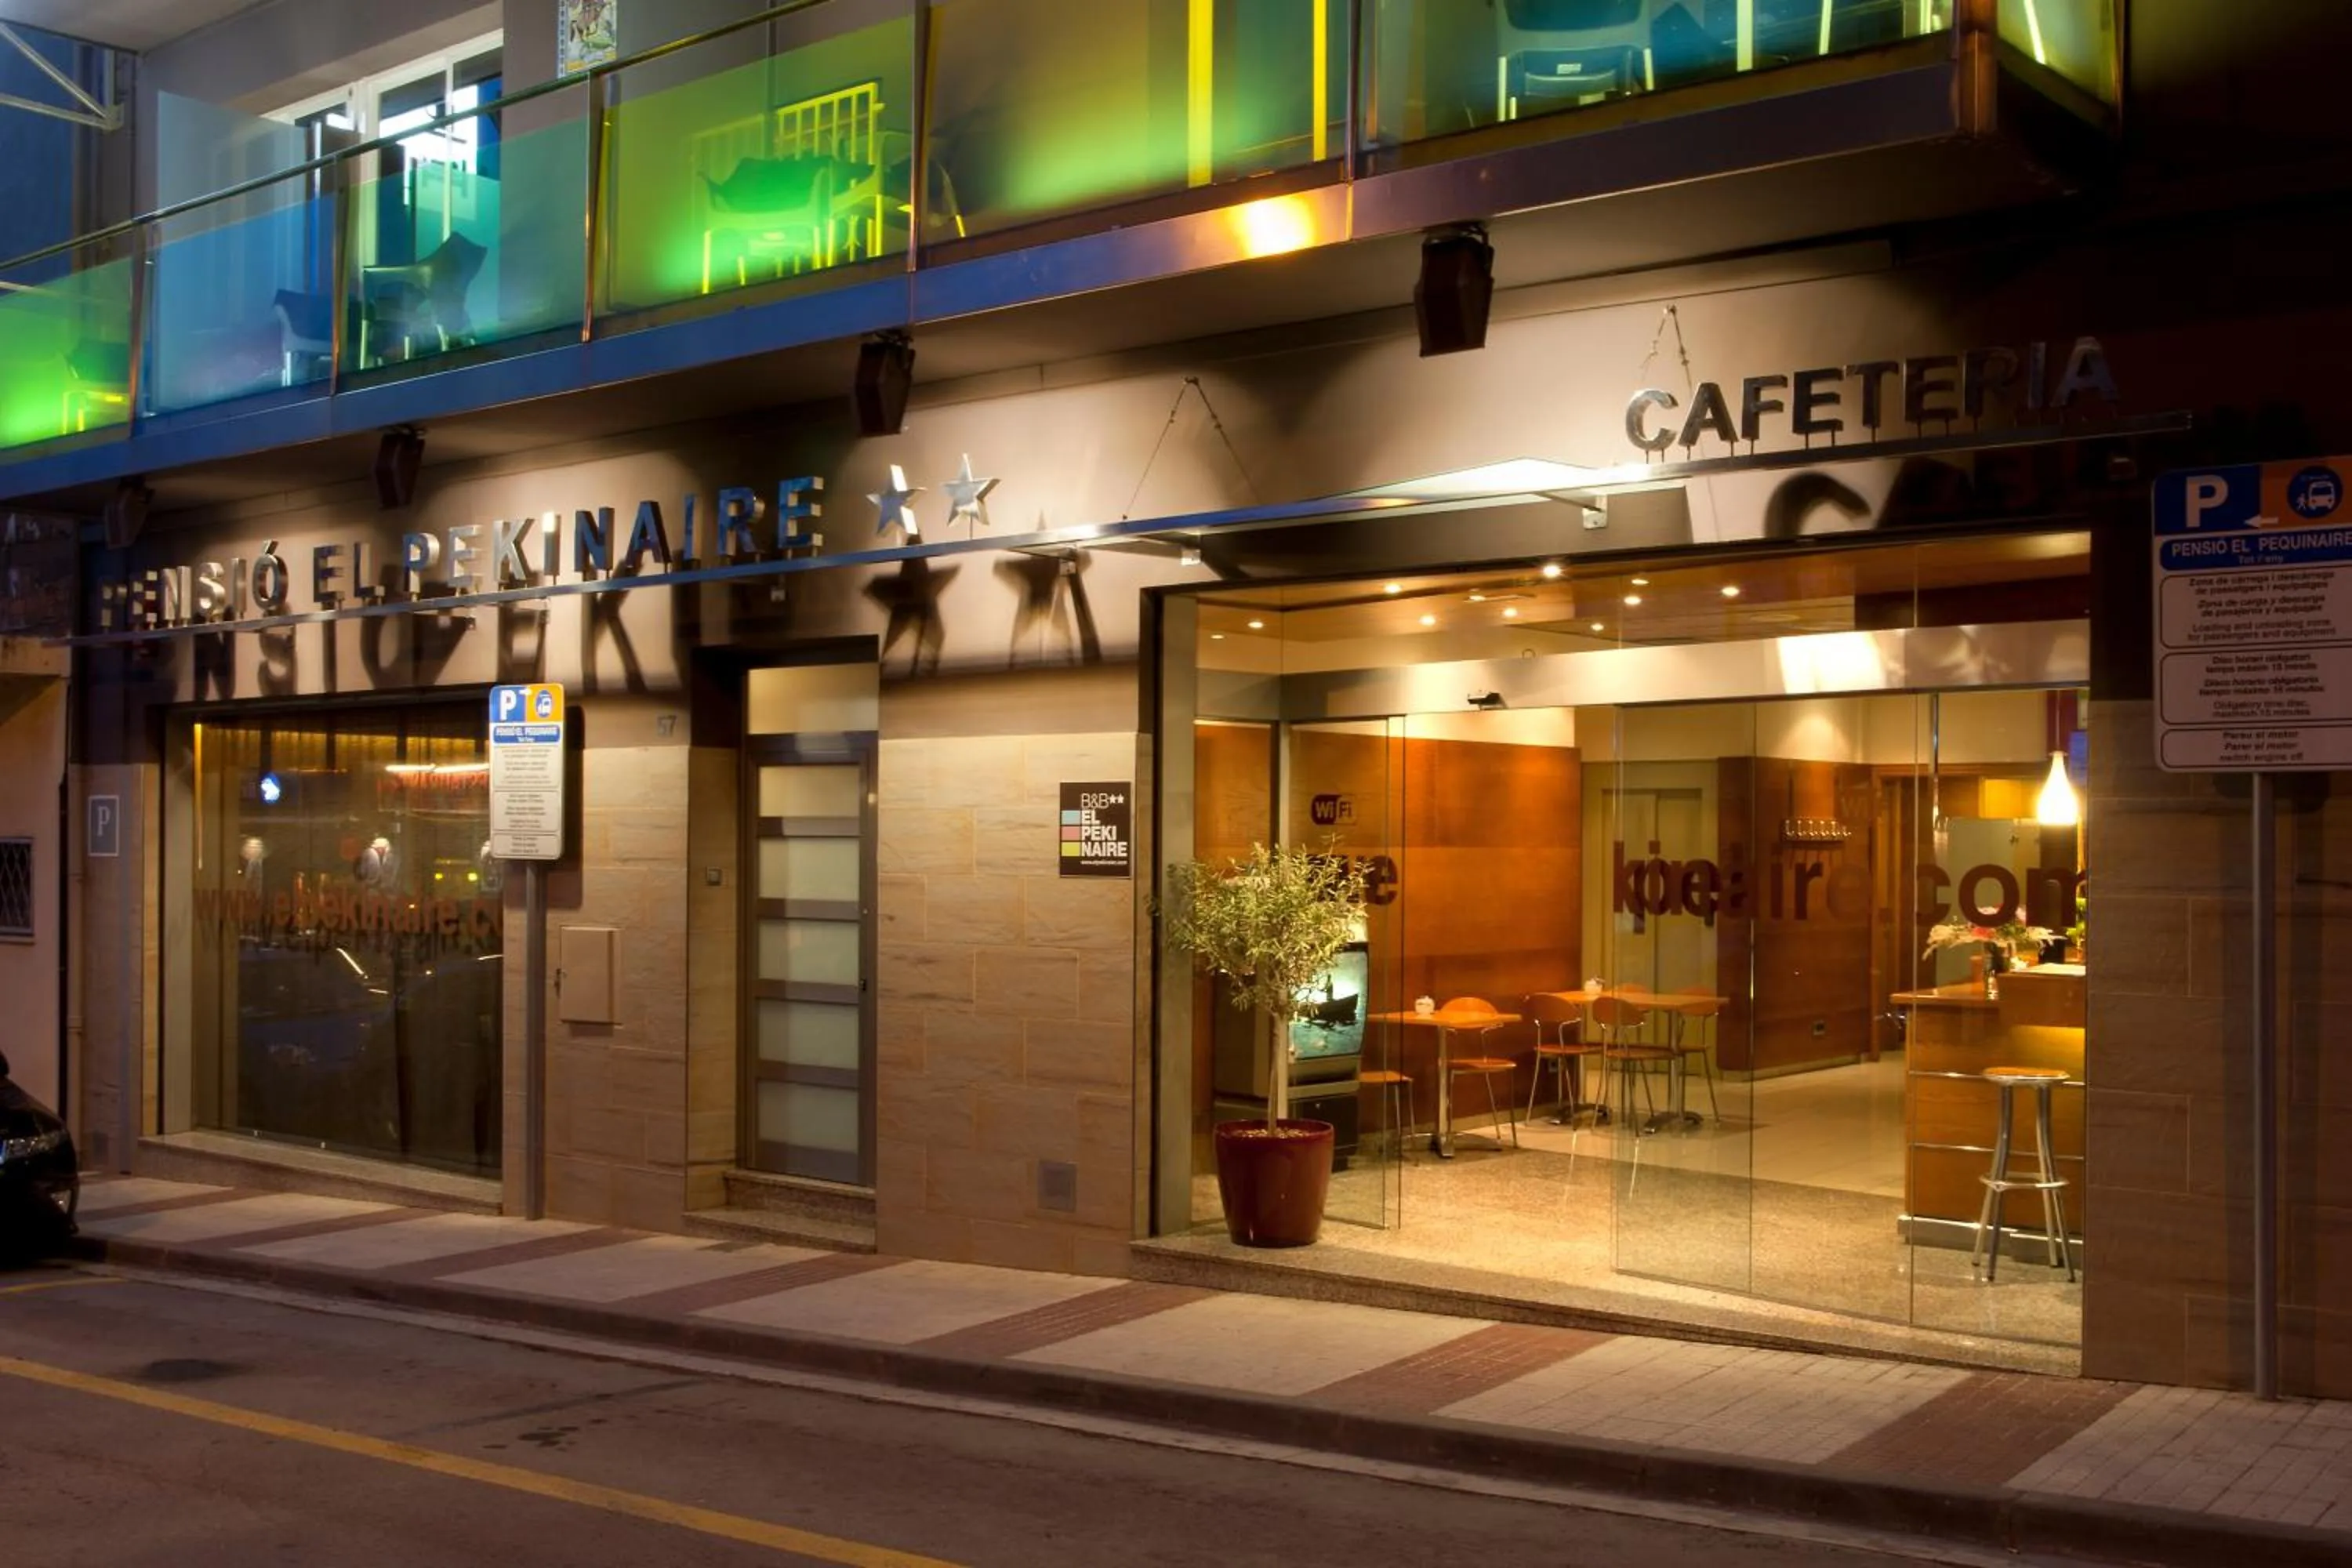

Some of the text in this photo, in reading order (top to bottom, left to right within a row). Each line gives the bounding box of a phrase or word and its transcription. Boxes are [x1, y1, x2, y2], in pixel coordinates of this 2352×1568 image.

[1625, 336, 2119, 451] CAFETERIA
[2184, 474, 2229, 528] P
[97, 475, 824, 627] PENSIÓ EL PEKINAIRE
[2231, 538, 2251, 554] EL
[2258, 530, 2352, 551] PEQUINAIRE
[499, 689, 517, 721] P
[96, 805, 111, 838] P
[1081, 809, 1102, 825] EL
[1081, 826, 1117, 841] PEKI
[1081, 841, 1128, 857] NAIRE
